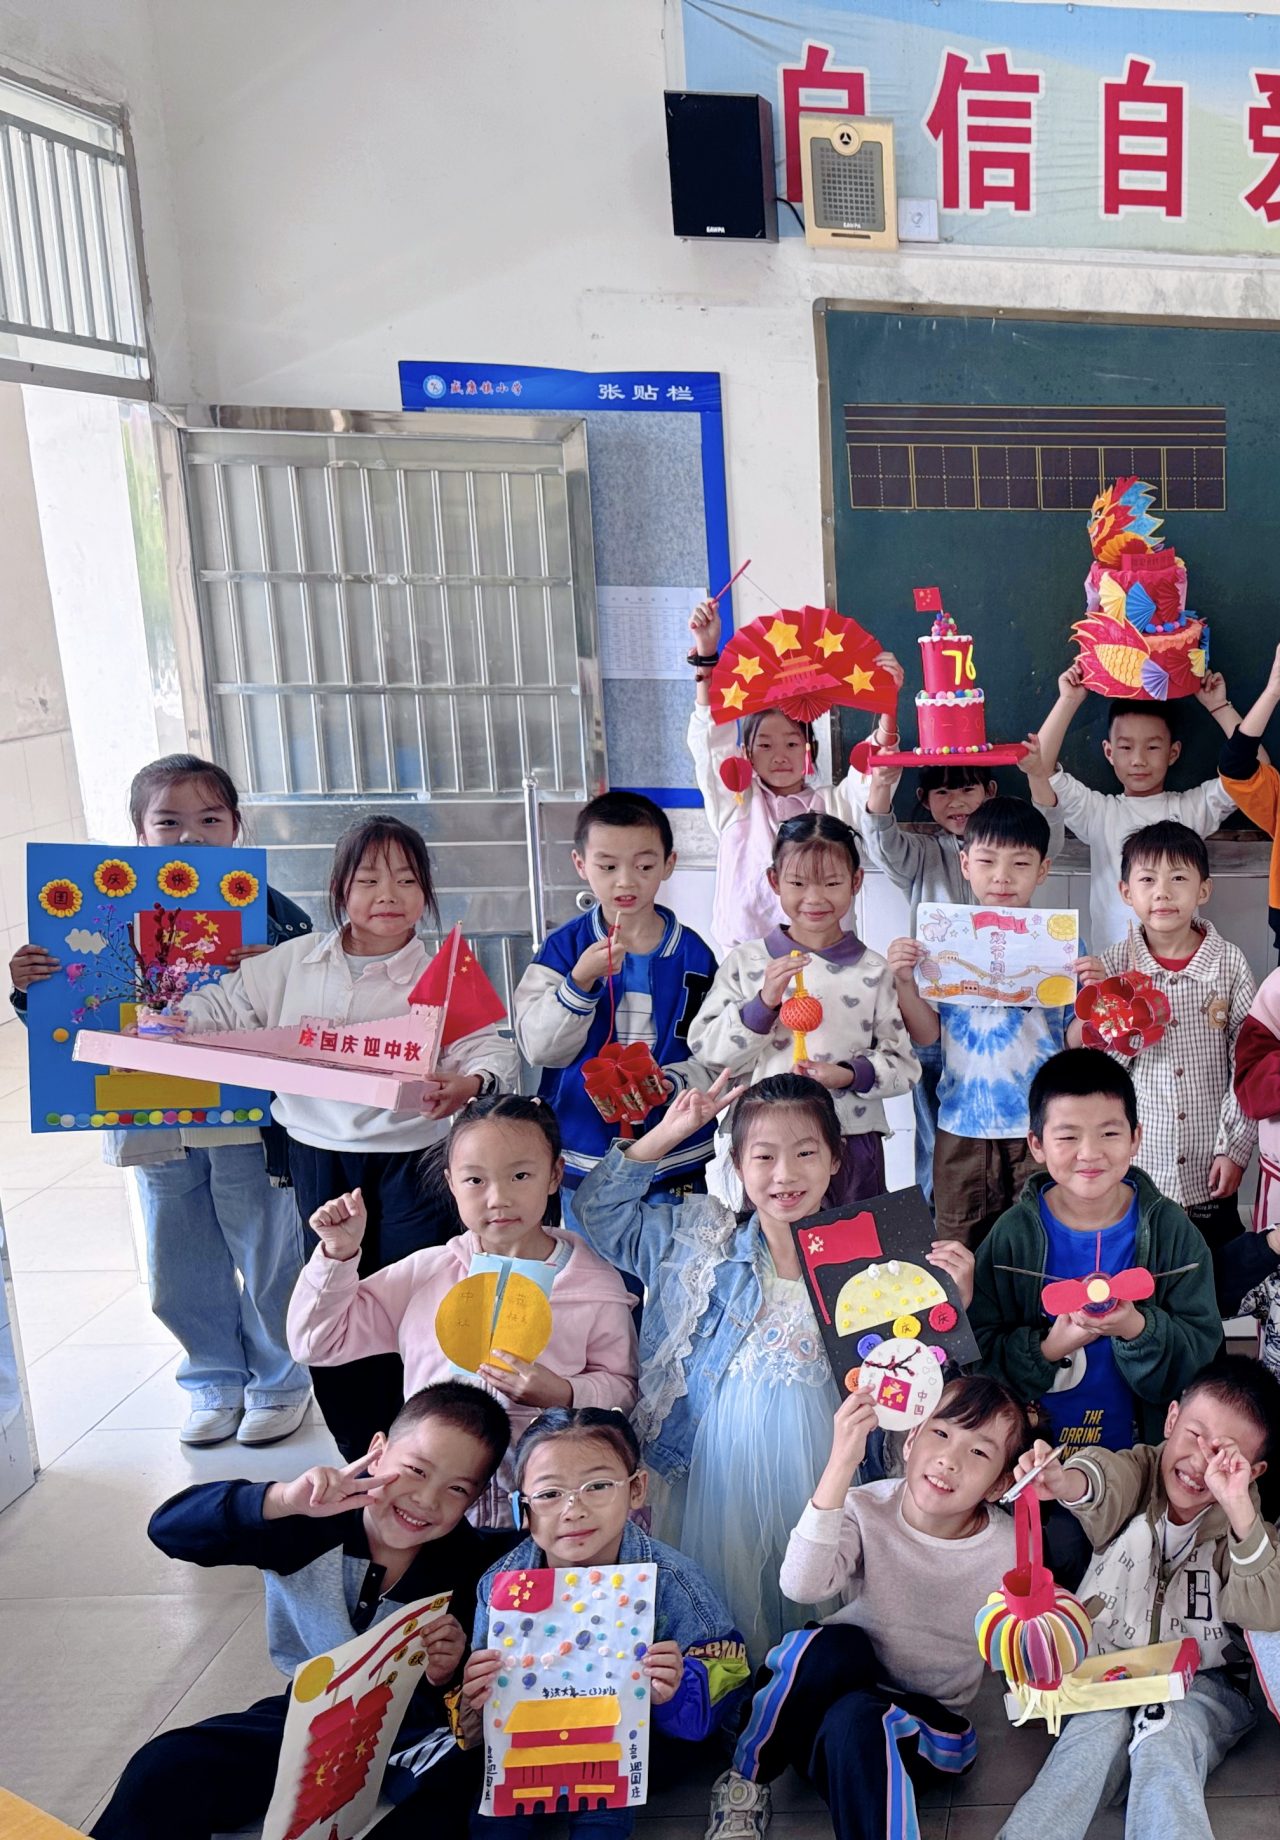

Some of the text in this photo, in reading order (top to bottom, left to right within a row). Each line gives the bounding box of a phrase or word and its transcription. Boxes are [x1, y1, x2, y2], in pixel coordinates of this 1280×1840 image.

[598, 383, 694, 401] 张贴栏
[942, 644, 976, 685] 76
[1083, 1410, 1104, 1425] THE
[1059, 1427, 1103, 1444] DARING
